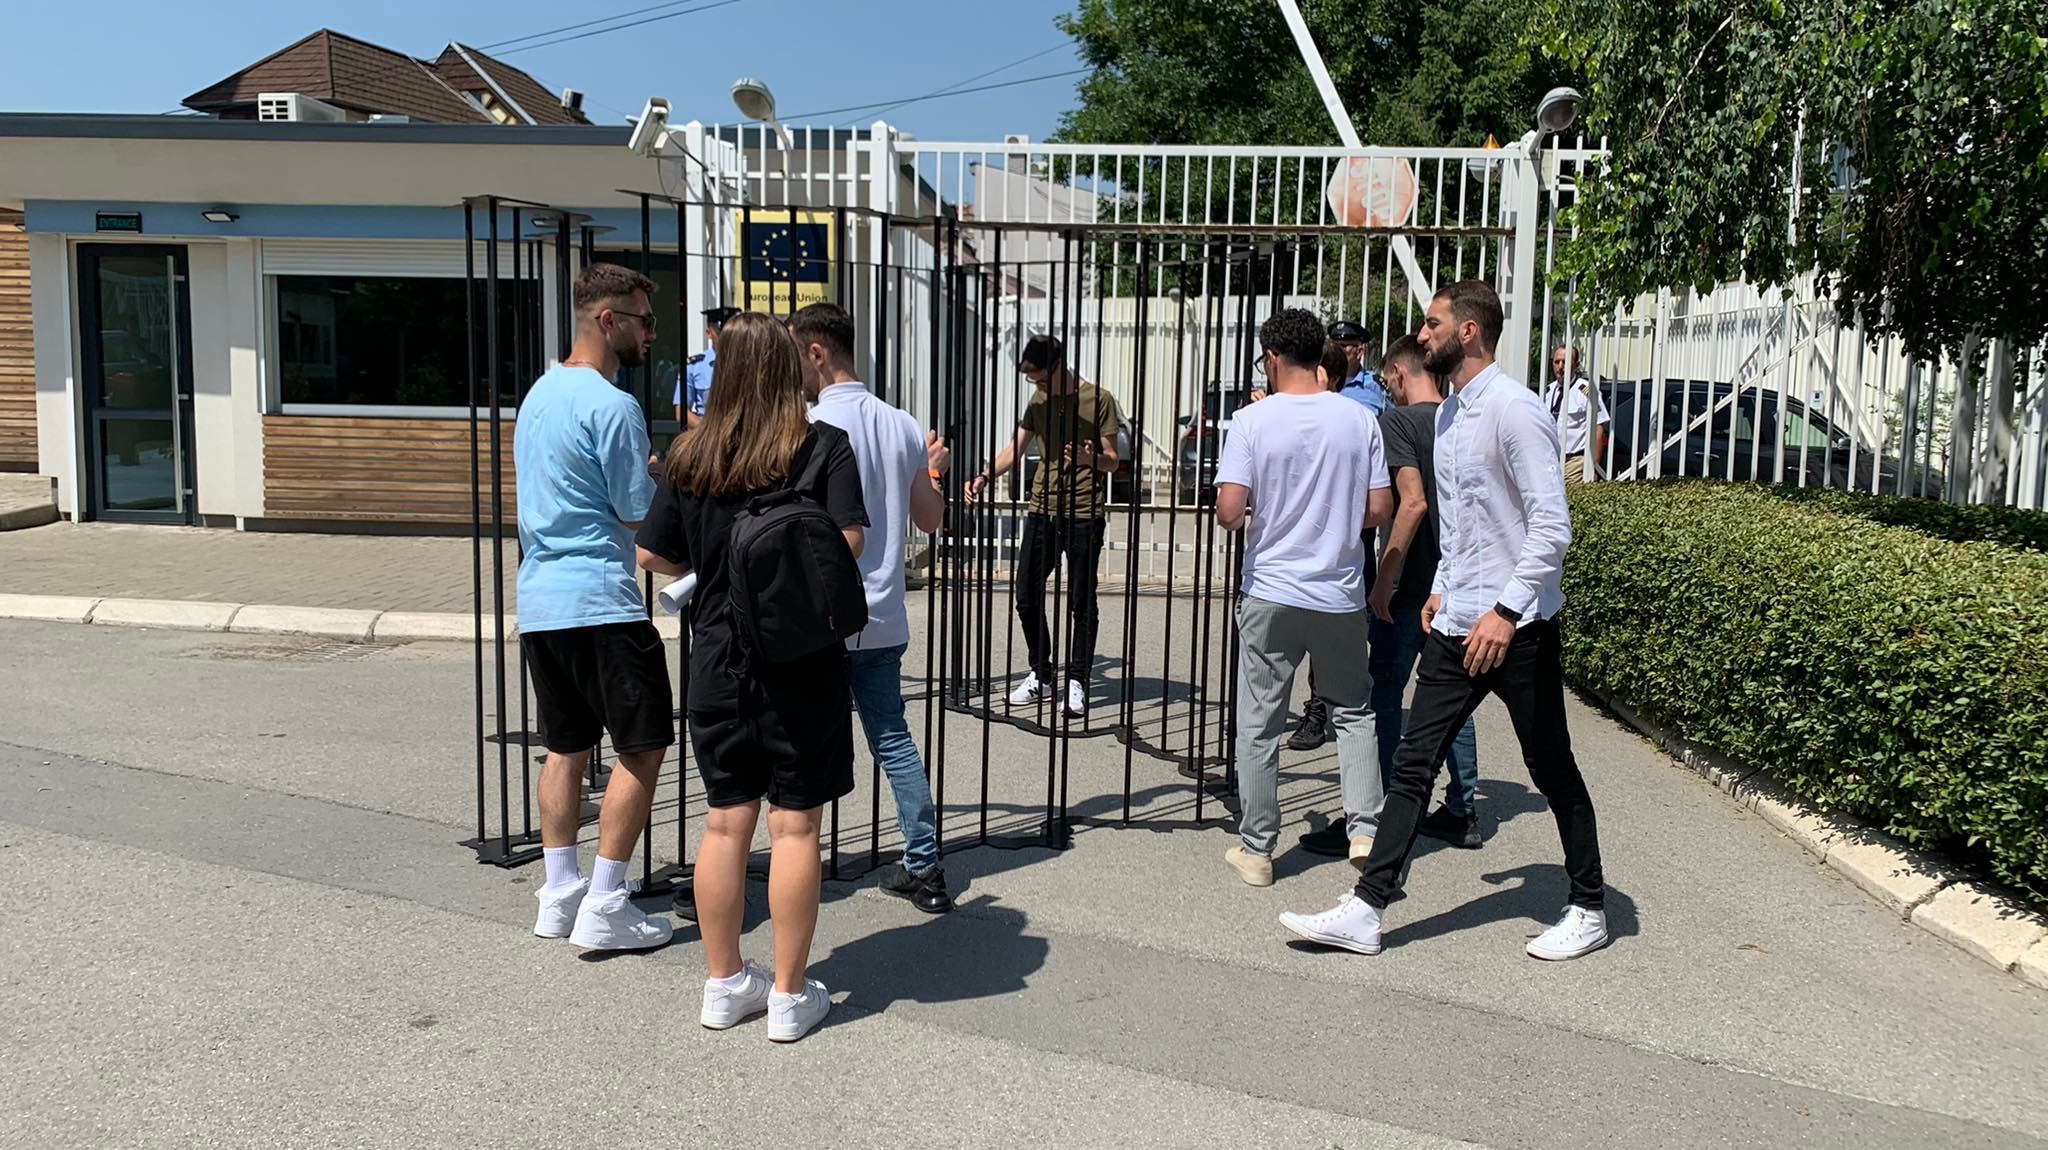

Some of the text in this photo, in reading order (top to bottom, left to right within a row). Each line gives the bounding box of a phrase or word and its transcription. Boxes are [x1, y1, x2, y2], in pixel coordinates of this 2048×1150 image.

[99, 217, 137, 228] ENTRANCE
[745, 292, 828, 303] uroea Union
